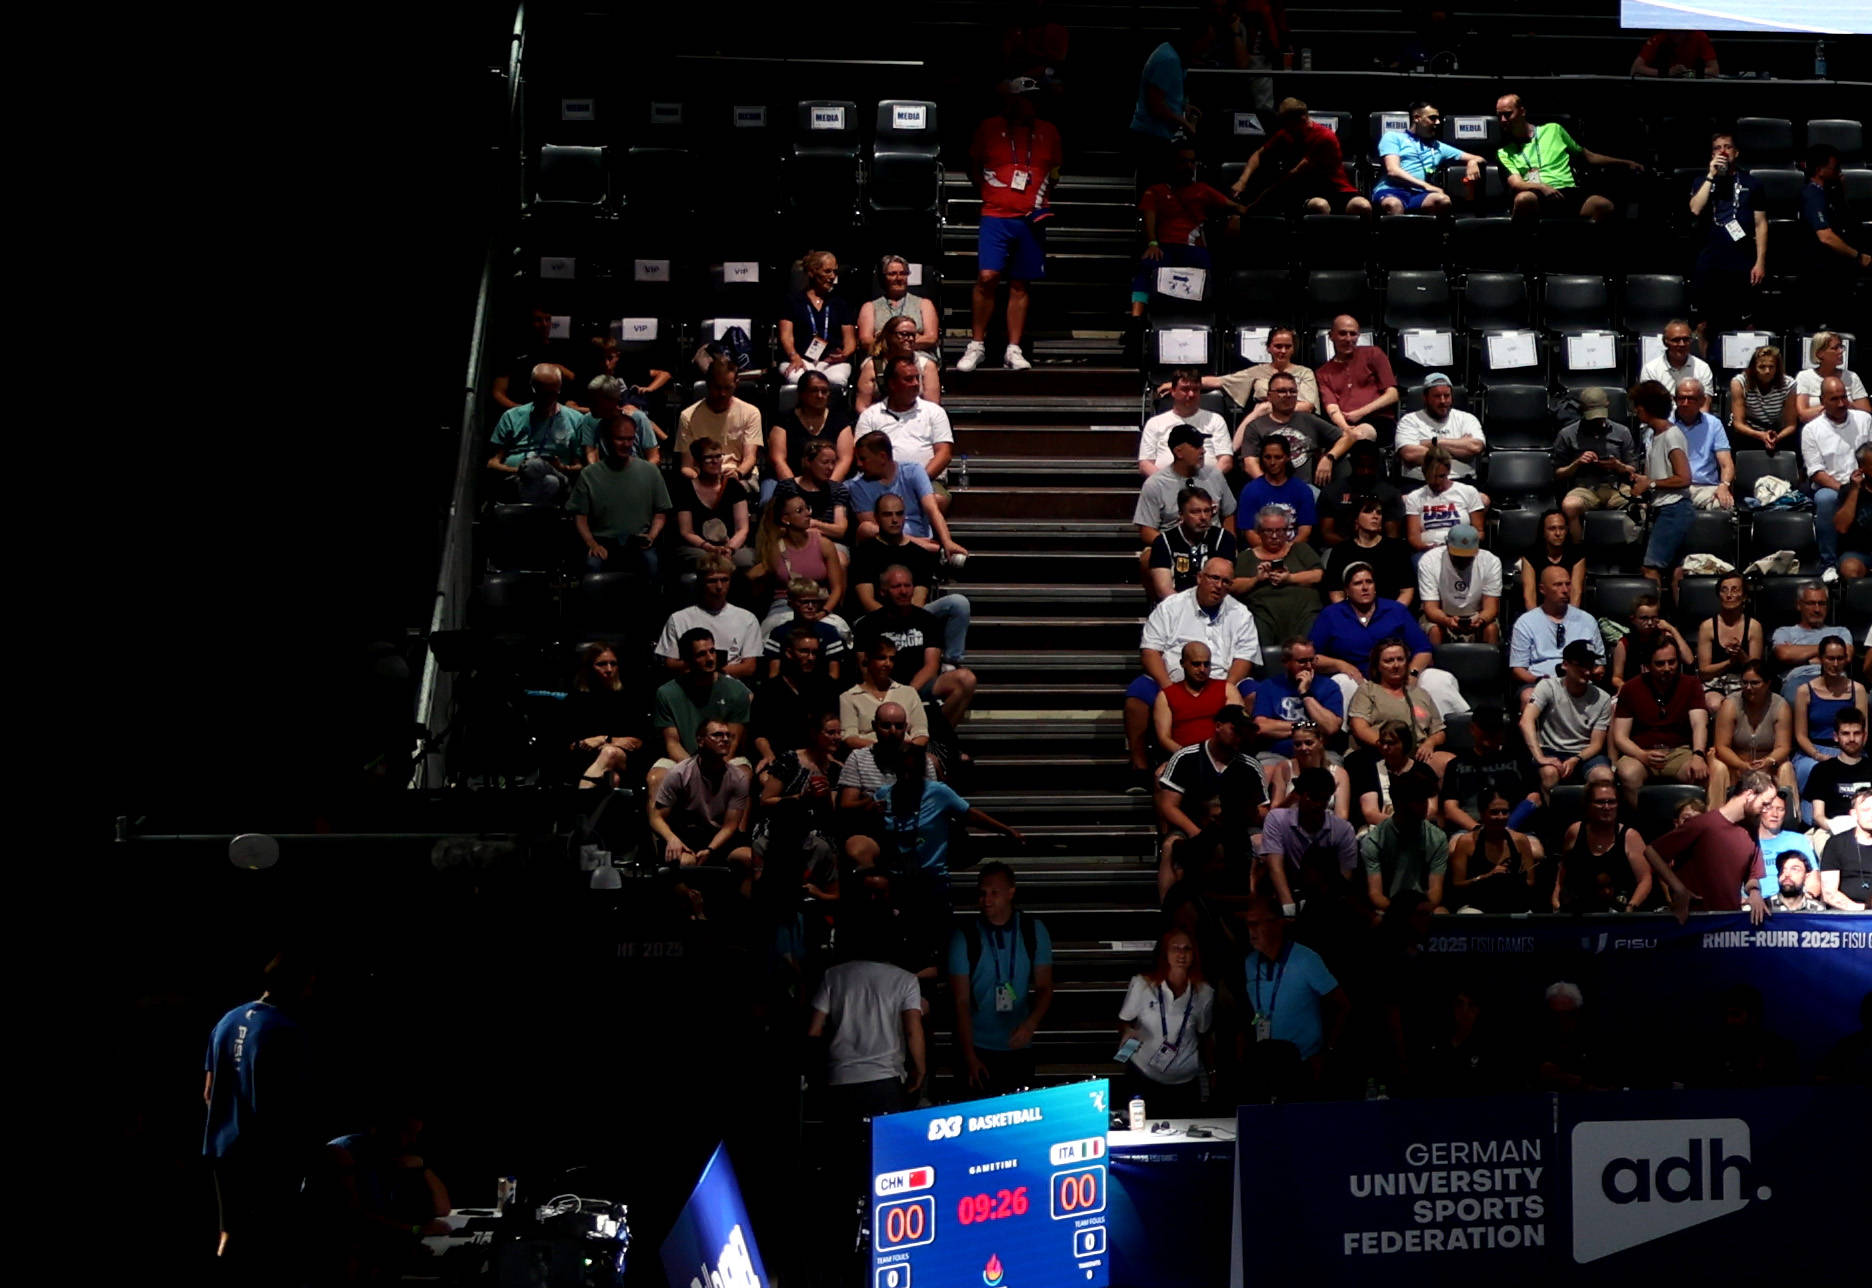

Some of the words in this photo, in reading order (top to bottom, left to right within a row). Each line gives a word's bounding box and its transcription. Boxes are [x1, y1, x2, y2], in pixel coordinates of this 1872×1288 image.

[815, 113, 840, 122] MEDIA
[897, 111, 921, 121] MEDIA
[1459, 123, 1482, 132] MEDIA
[1424, 503, 1459, 521] USA
[1428, 936, 1468, 952] 2025
[1496, 935, 1535, 953] GAMES
[1614, 938, 1658, 949] FISU
[1702, 930, 1799, 949] RHINE-RUHR
[1801, 930, 1841, 948] 2025
[1842, 931, 1866, 949] FISU
[967, 1106, 1043, 1133] BASKETBALL
[1058, 1146, 1075, 1159] ITA
[1405, 1138, 1542, 1166] GERMAN
[881, 1176, 904, 1191] CHN
[1060, 1172, 1096, 1211] 00
[1349, 1167, 1544, 1198] UNIVERSITY
[957, 1186, 1030, 1226] 09:26
[1413, 1195, 1545, 1224] SPORTS
[885, 1203, 925, 1243] 00
[1084, 1232, 1095, 1251] 0
[1343, 1223, 1545, 1255] FEDERATION
[886, 1269, 899, 1288] 0
